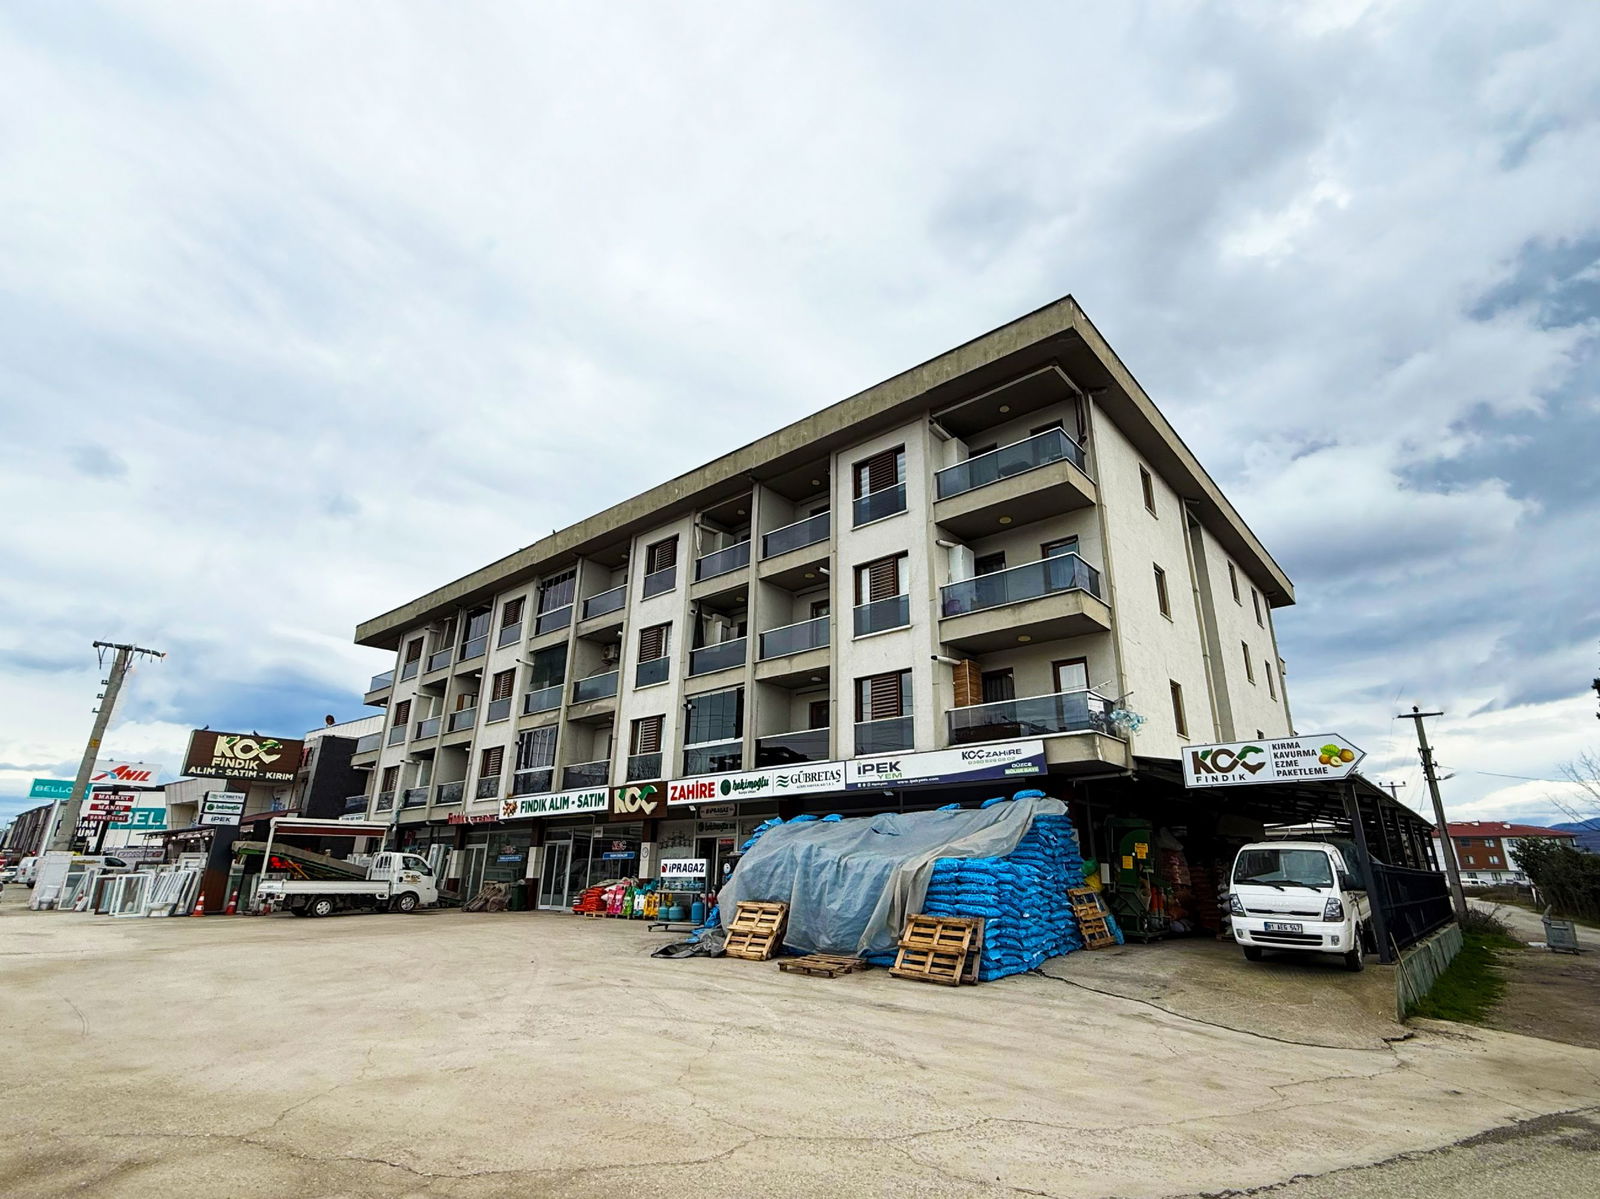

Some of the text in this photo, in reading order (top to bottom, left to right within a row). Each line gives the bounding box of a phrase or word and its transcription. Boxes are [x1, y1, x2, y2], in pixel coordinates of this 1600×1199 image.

[1271, 741, 1300, 751] KIRMA
[1273, 749, 1317, 760] KAVURMA
[211, 757, 260, 770] FINDIK
[1274, 759, 1300, 768] EZME
[188, 766, 216, 775] ALIM
[225, 768, 257, 778] SATIM
[265, 771, 294, 781] KIRIM
[877, 772, 903, 780] YEM
[1276, 766, 1328, 777] PAKETLEME
[1196, 774, 1247, 784] FINDIK
[670, 780, 716, 801] ZAHİRE
[98, 803, 125, 811] MANAV
[519, 798, 547, 814] FINDIK
[548, 795, 570, 810] ALIM
[577, 792, 605, 809] SATIM
